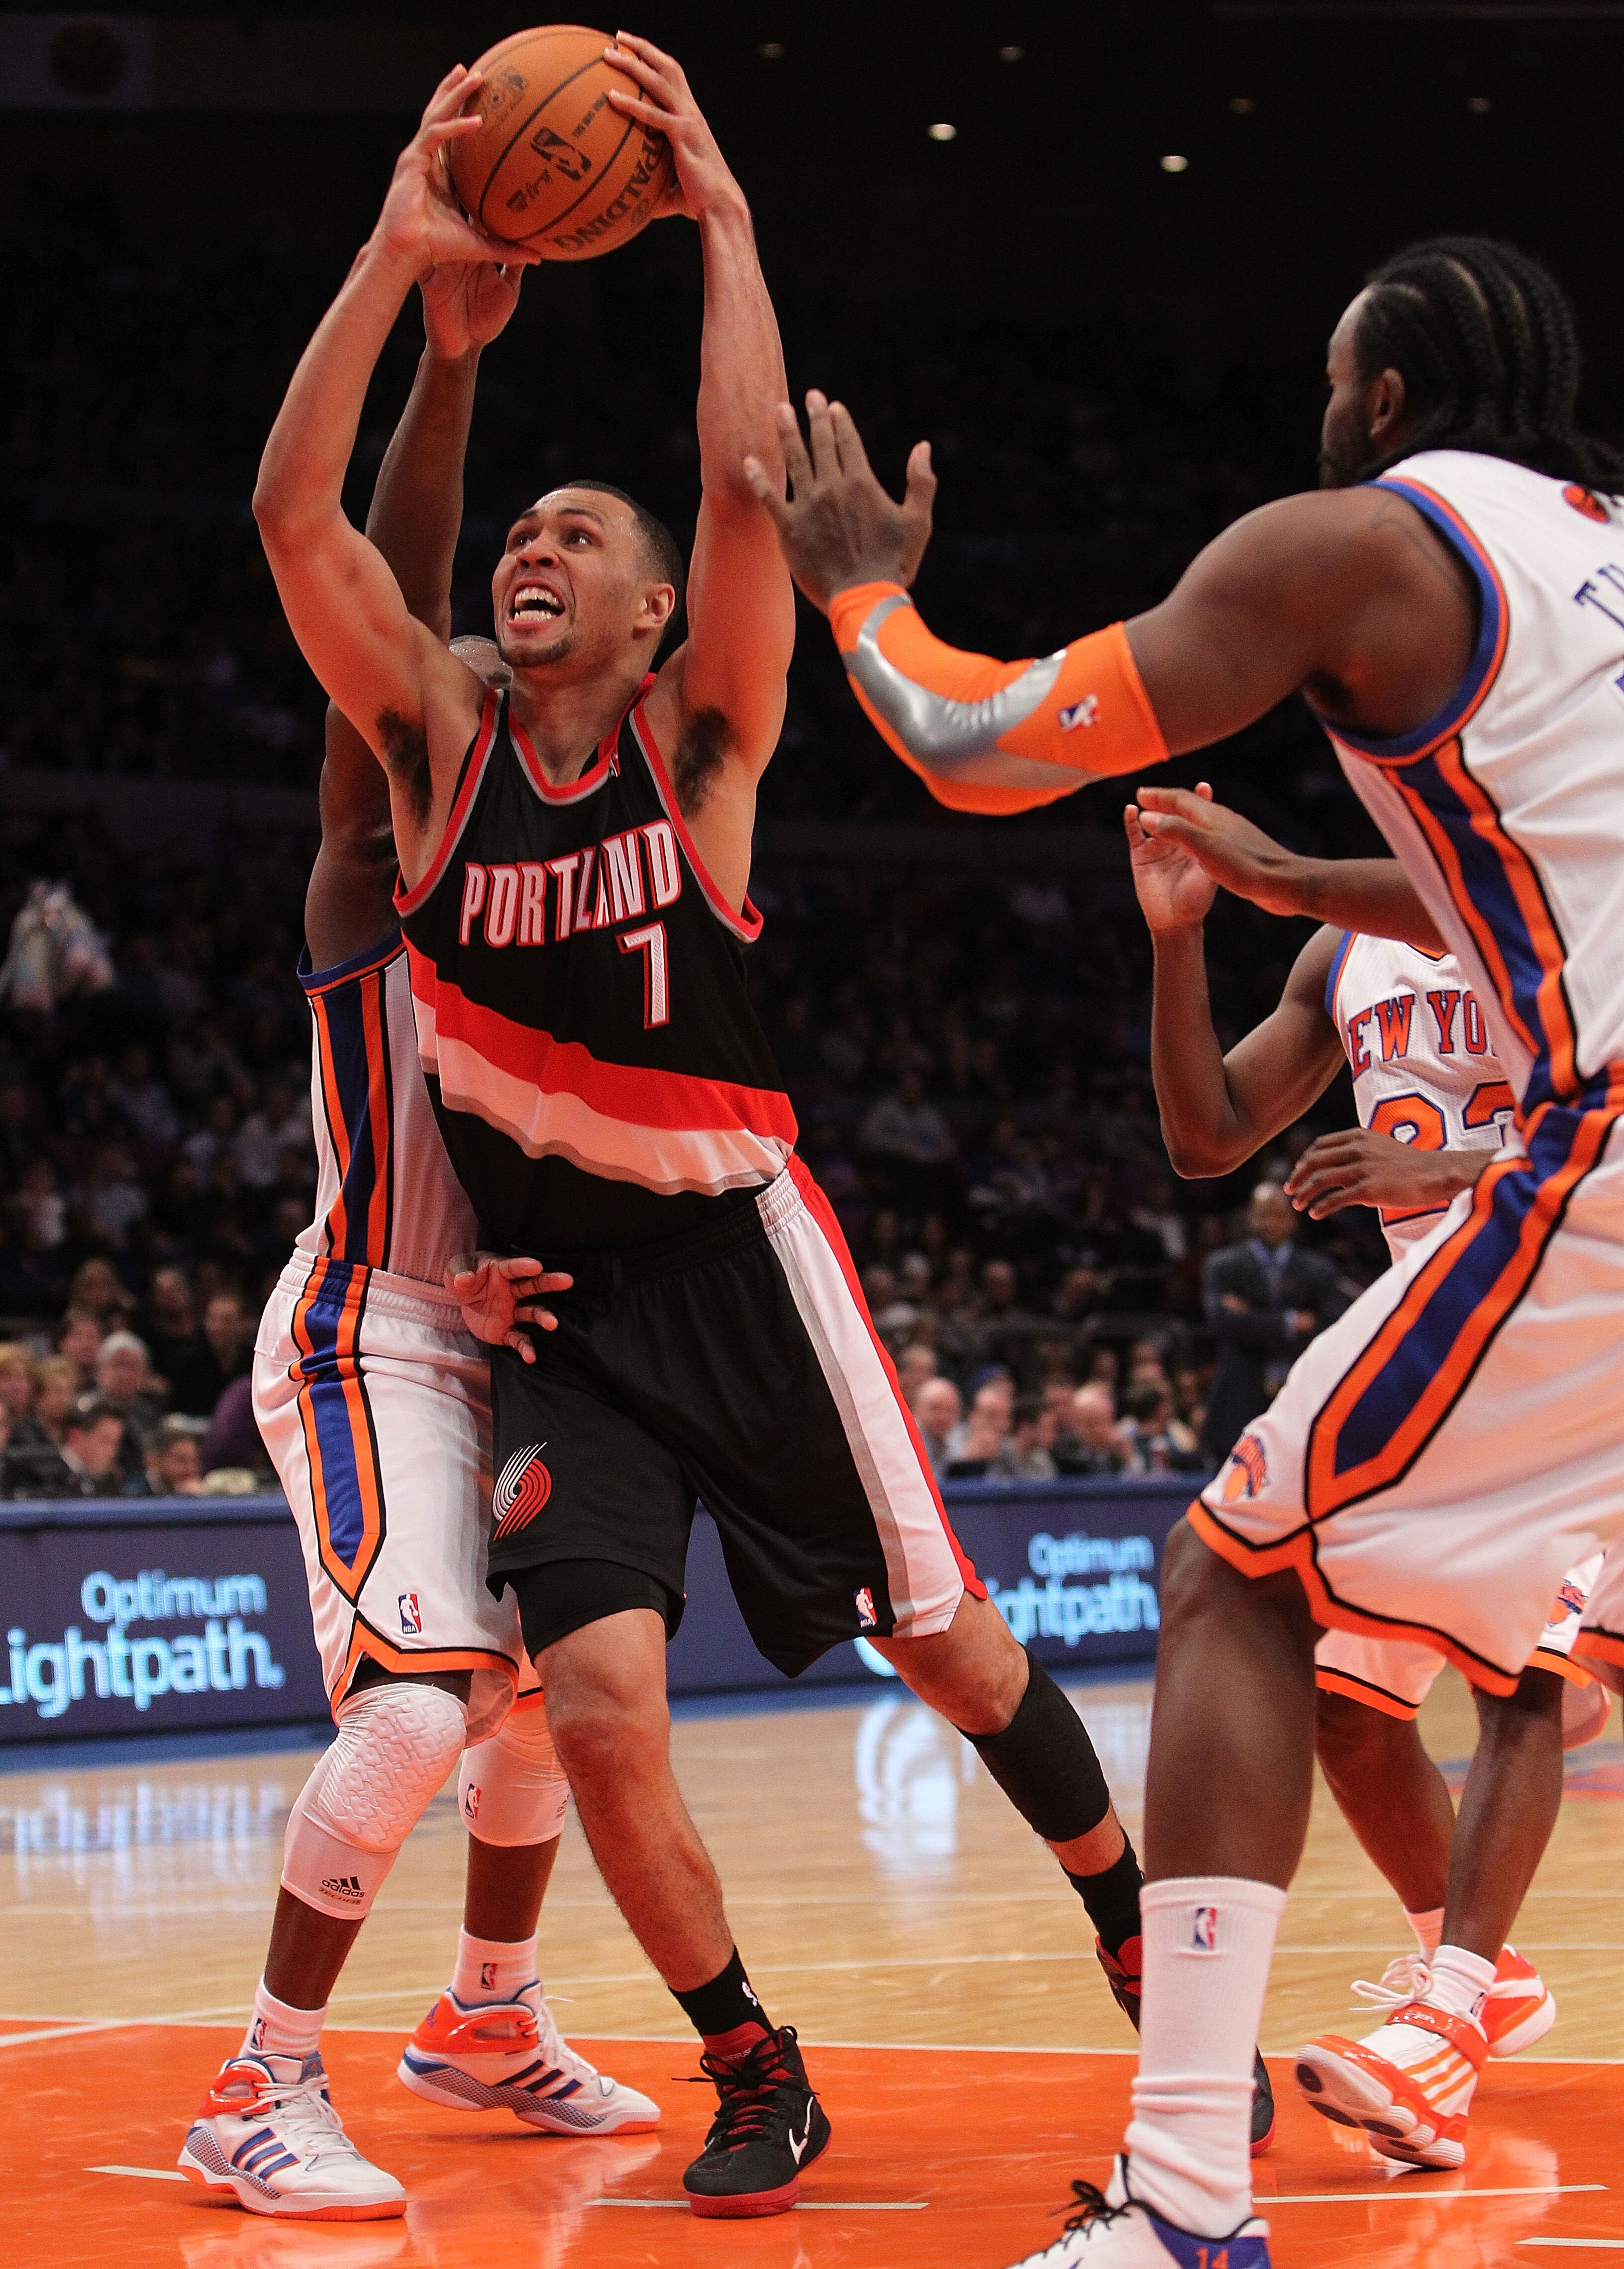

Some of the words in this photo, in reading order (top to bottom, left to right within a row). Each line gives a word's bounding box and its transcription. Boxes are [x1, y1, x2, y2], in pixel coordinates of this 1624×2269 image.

[553, 132, 662, 250] PALDING
[615, 921, 670, 1030] 7
[1348, 994, 1416, 1082] EW
[1426, 990, 1499, 1057] YO
[81, 1569, 268, 1629] Optimum
[322, 1880, 365, 1898] adidas
[1196, 2247, 1229, 2269] 14
